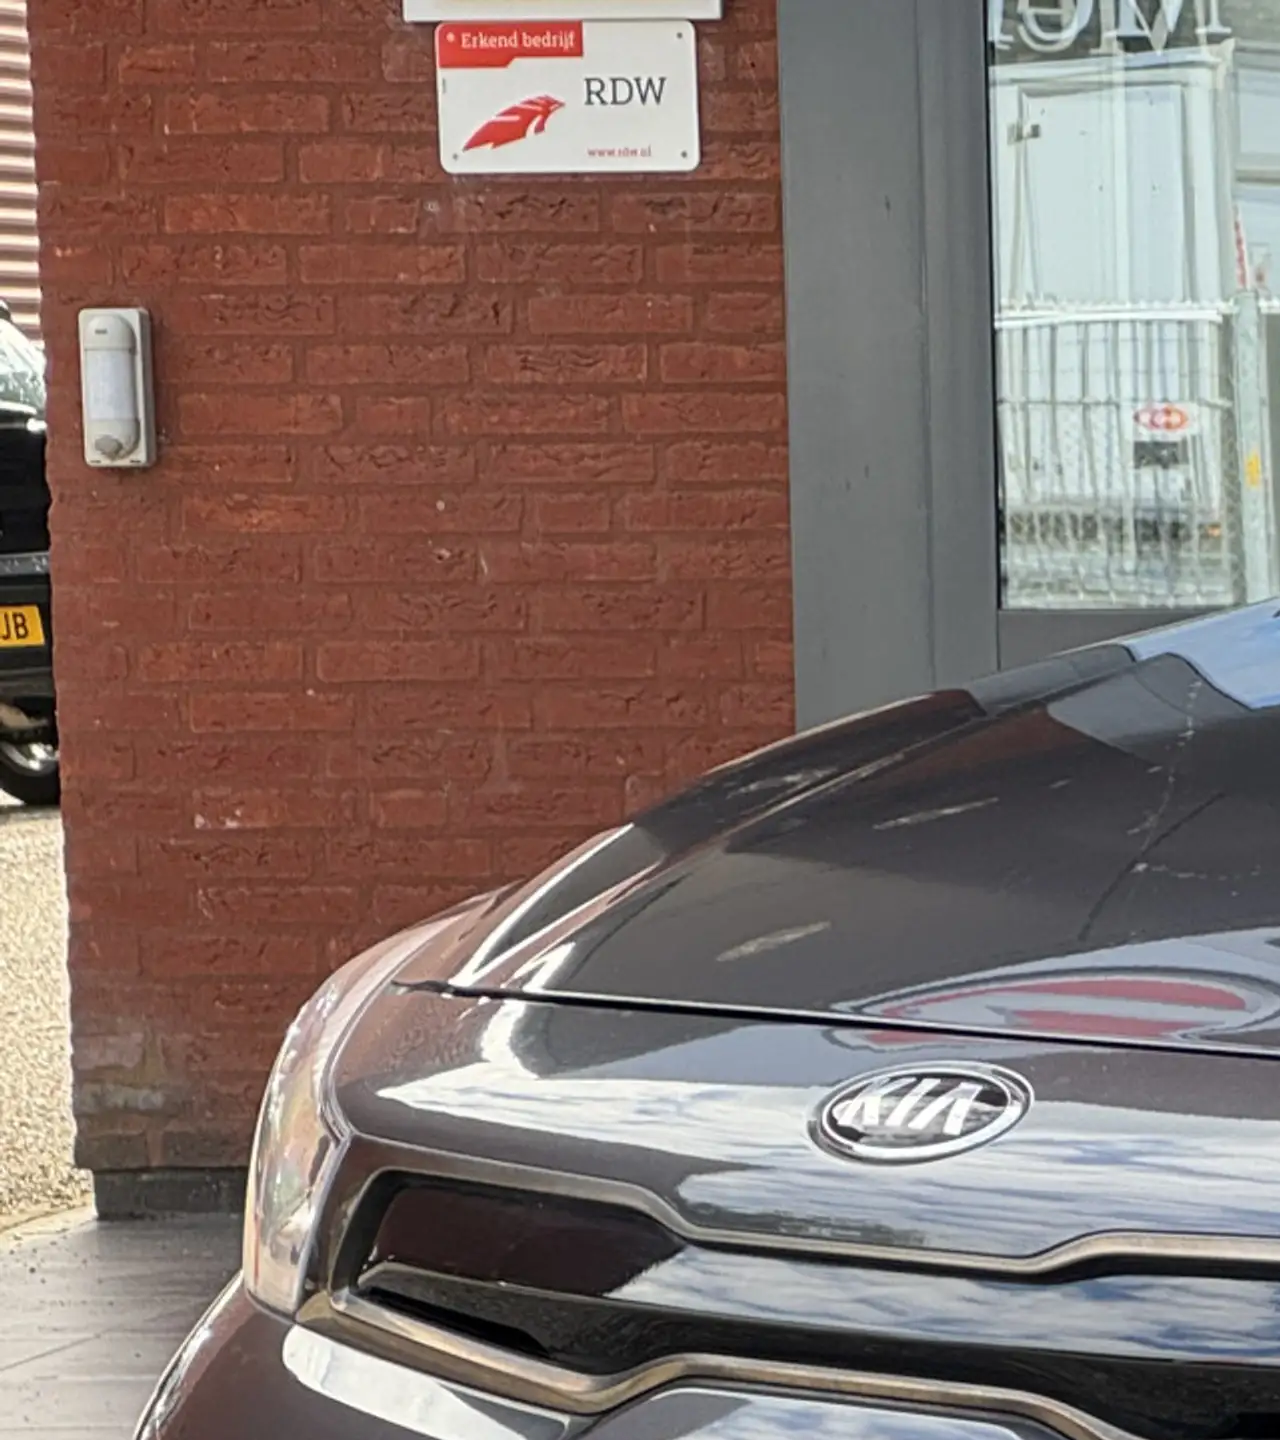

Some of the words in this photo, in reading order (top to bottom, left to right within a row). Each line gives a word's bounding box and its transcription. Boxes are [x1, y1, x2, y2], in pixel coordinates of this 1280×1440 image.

[461, 31, 518, 49] Erkend
[522, 31, 575, 51] bedrijf
[584, 76, 667, 106] RDW
[836, 1076, 984, 1136] KIA
